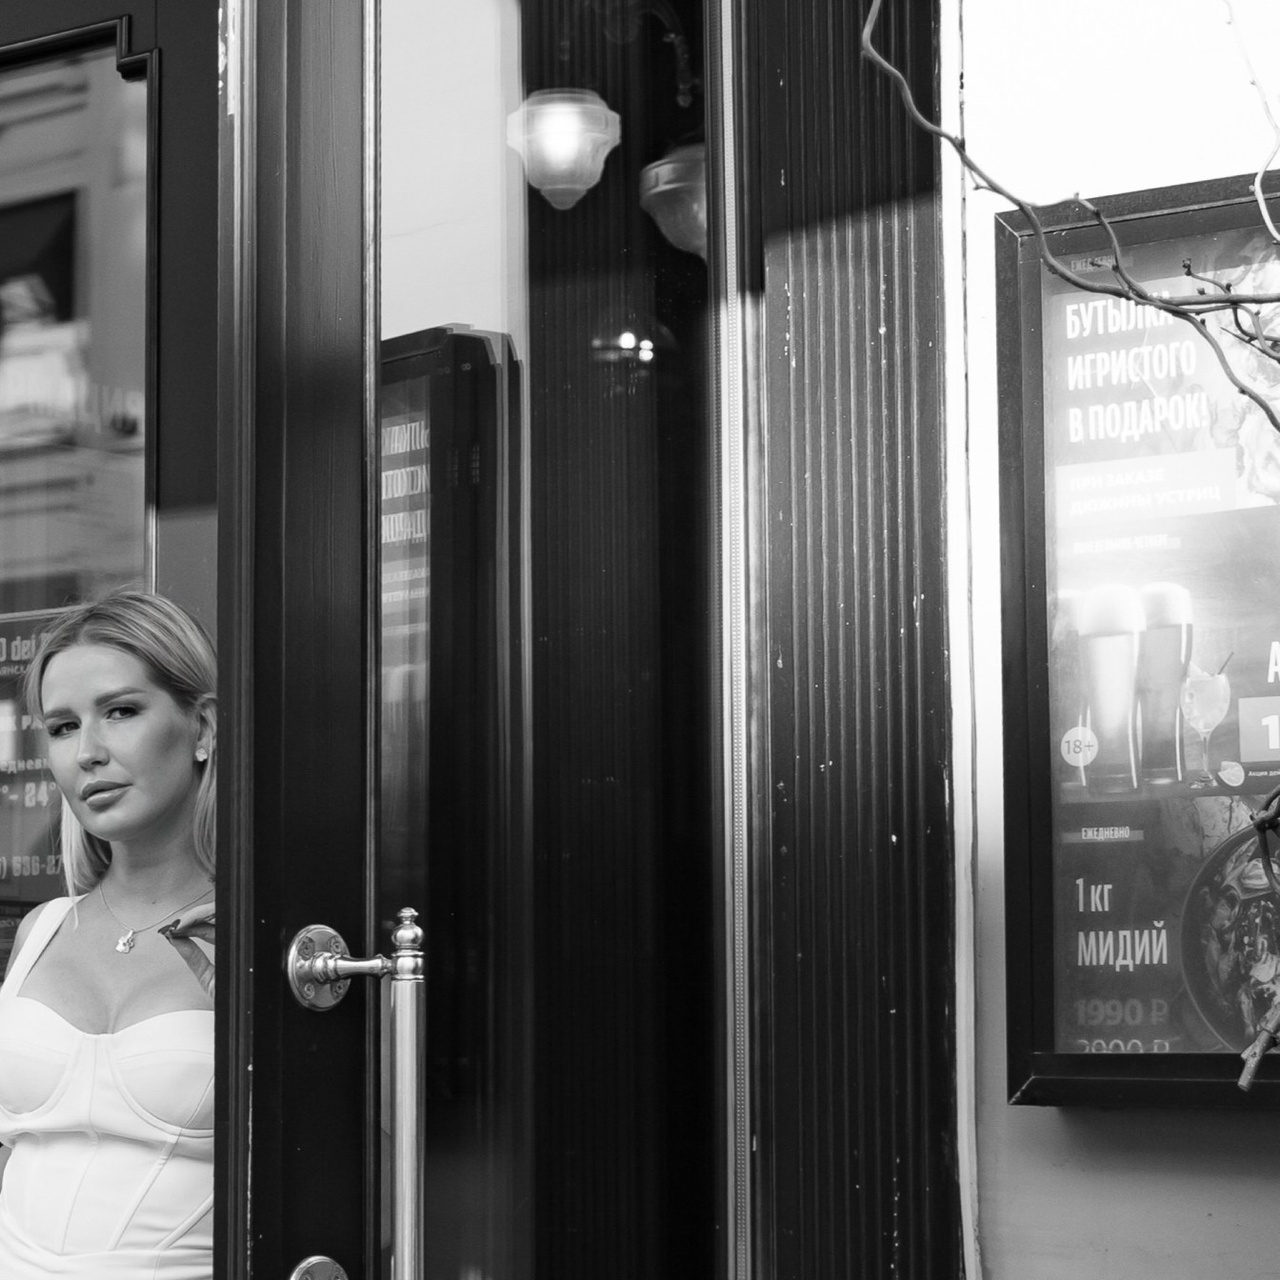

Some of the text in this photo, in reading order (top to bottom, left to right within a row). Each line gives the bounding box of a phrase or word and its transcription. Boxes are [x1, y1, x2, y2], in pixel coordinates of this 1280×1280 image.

[1067, 340, 1197, 391] ИГРИСТОГО
[1069, 392, 1208, 444] В ПОДАРОК!
[1105, 467, 1166, 487] ЗАКАЗЕ
[1069, 485, 1221, 517] ДЮЖИНЫ УСТРИЦ
[1064, 738, 1095, 756] 18+
[1081, 826, 1130, 841] ЕЖЕДНЕВНО
[1075, 877, 1085, 912] 1
[1077, 920, 1169, 972] МИДИЙ
